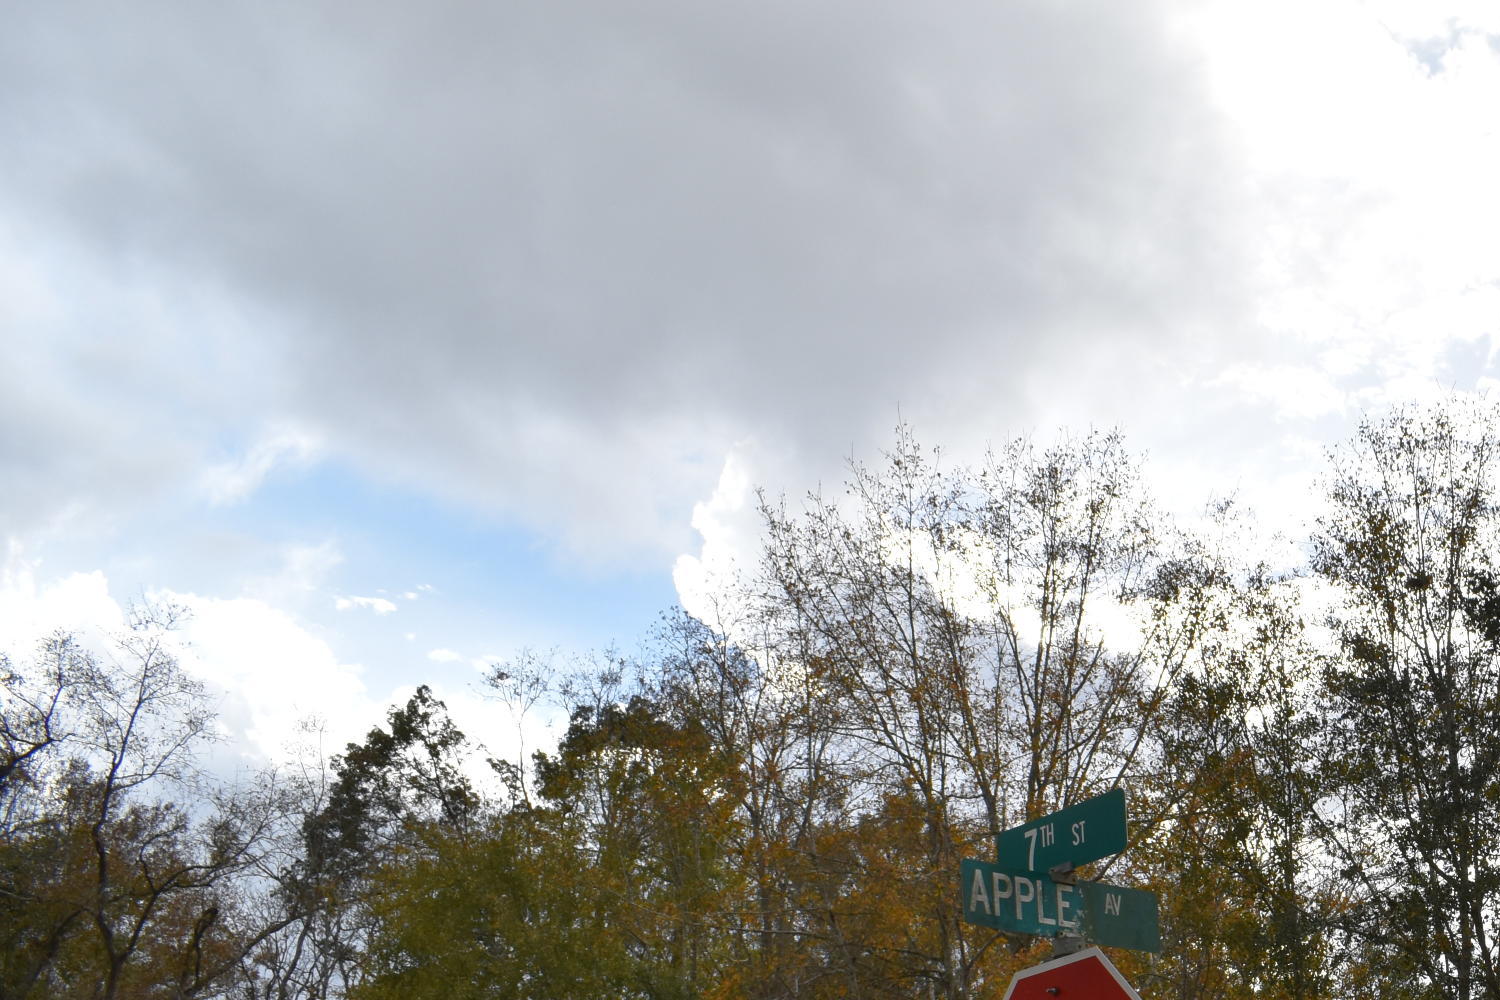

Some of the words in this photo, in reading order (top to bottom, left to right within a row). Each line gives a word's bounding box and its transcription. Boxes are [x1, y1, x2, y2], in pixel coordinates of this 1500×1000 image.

[1024, 822, 1055, 872] 7TH
[1071, 820, 1086, 846] ST
[969, 868, 1076, 928] APPLE
[1104, 892, 1122, 916] AV
